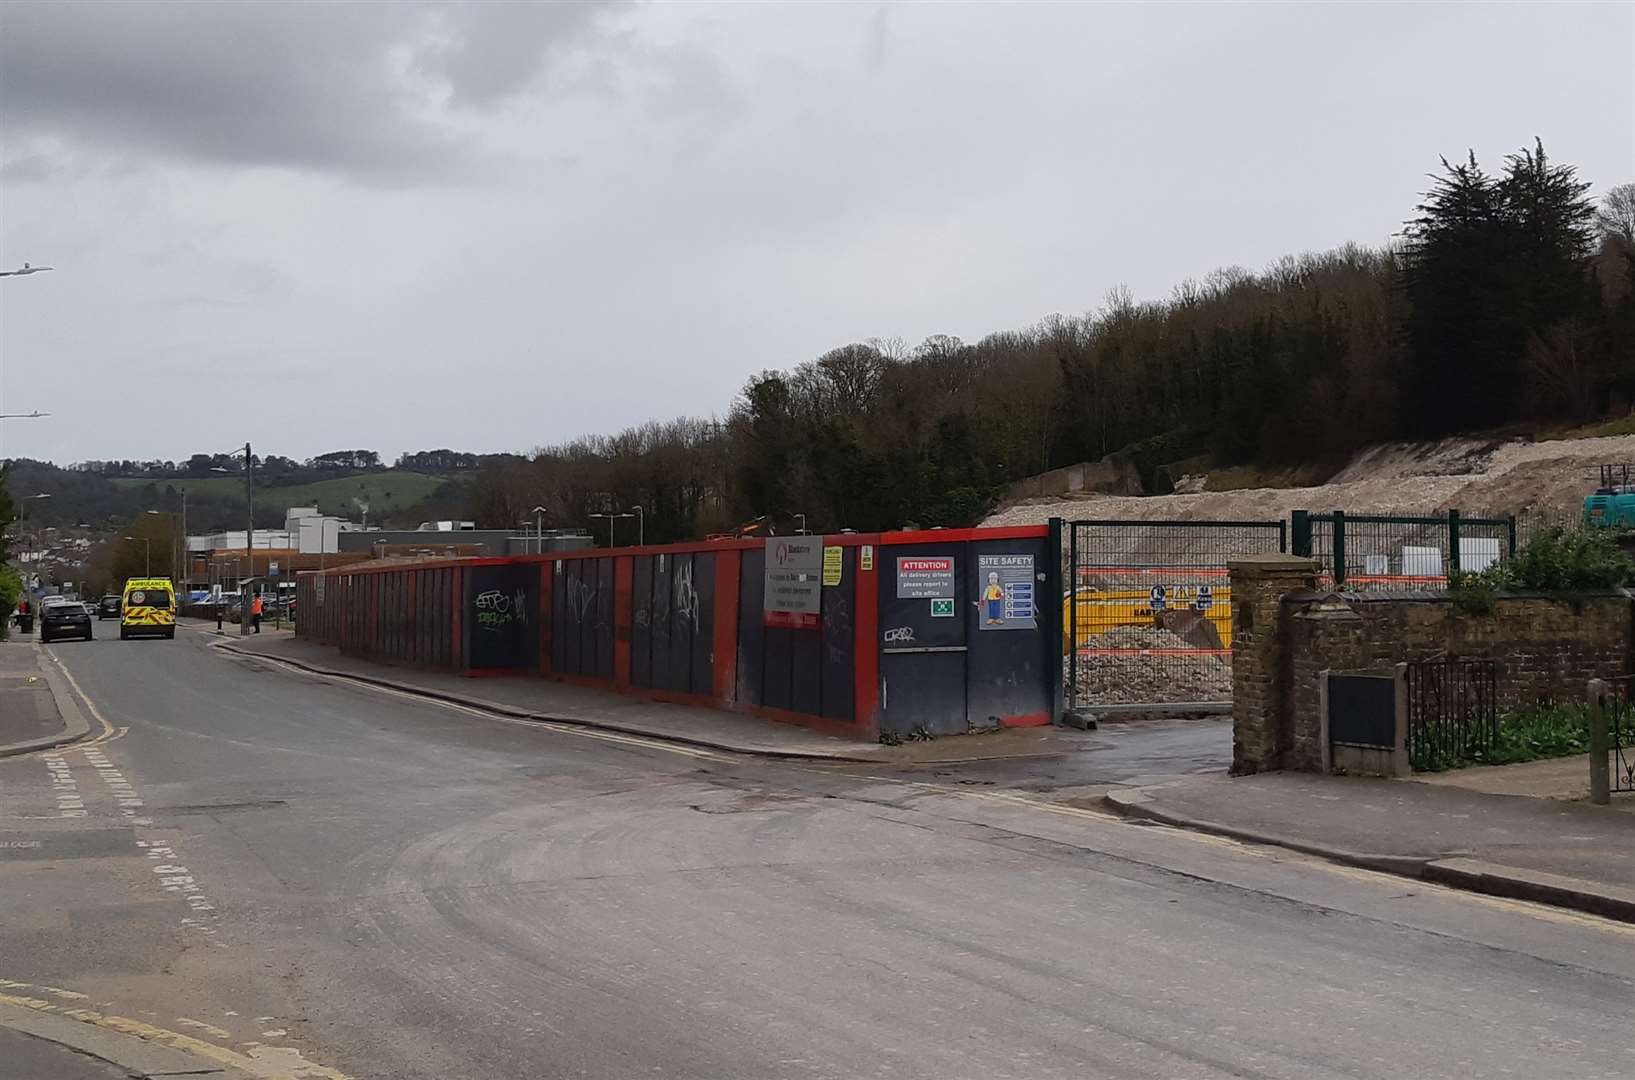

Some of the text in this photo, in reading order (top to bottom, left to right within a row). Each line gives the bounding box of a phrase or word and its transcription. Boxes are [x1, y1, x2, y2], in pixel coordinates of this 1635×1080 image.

[903, 561, 947, 569] ATTENTION
[979, 557, 1032, 565] SITE SAFETY
